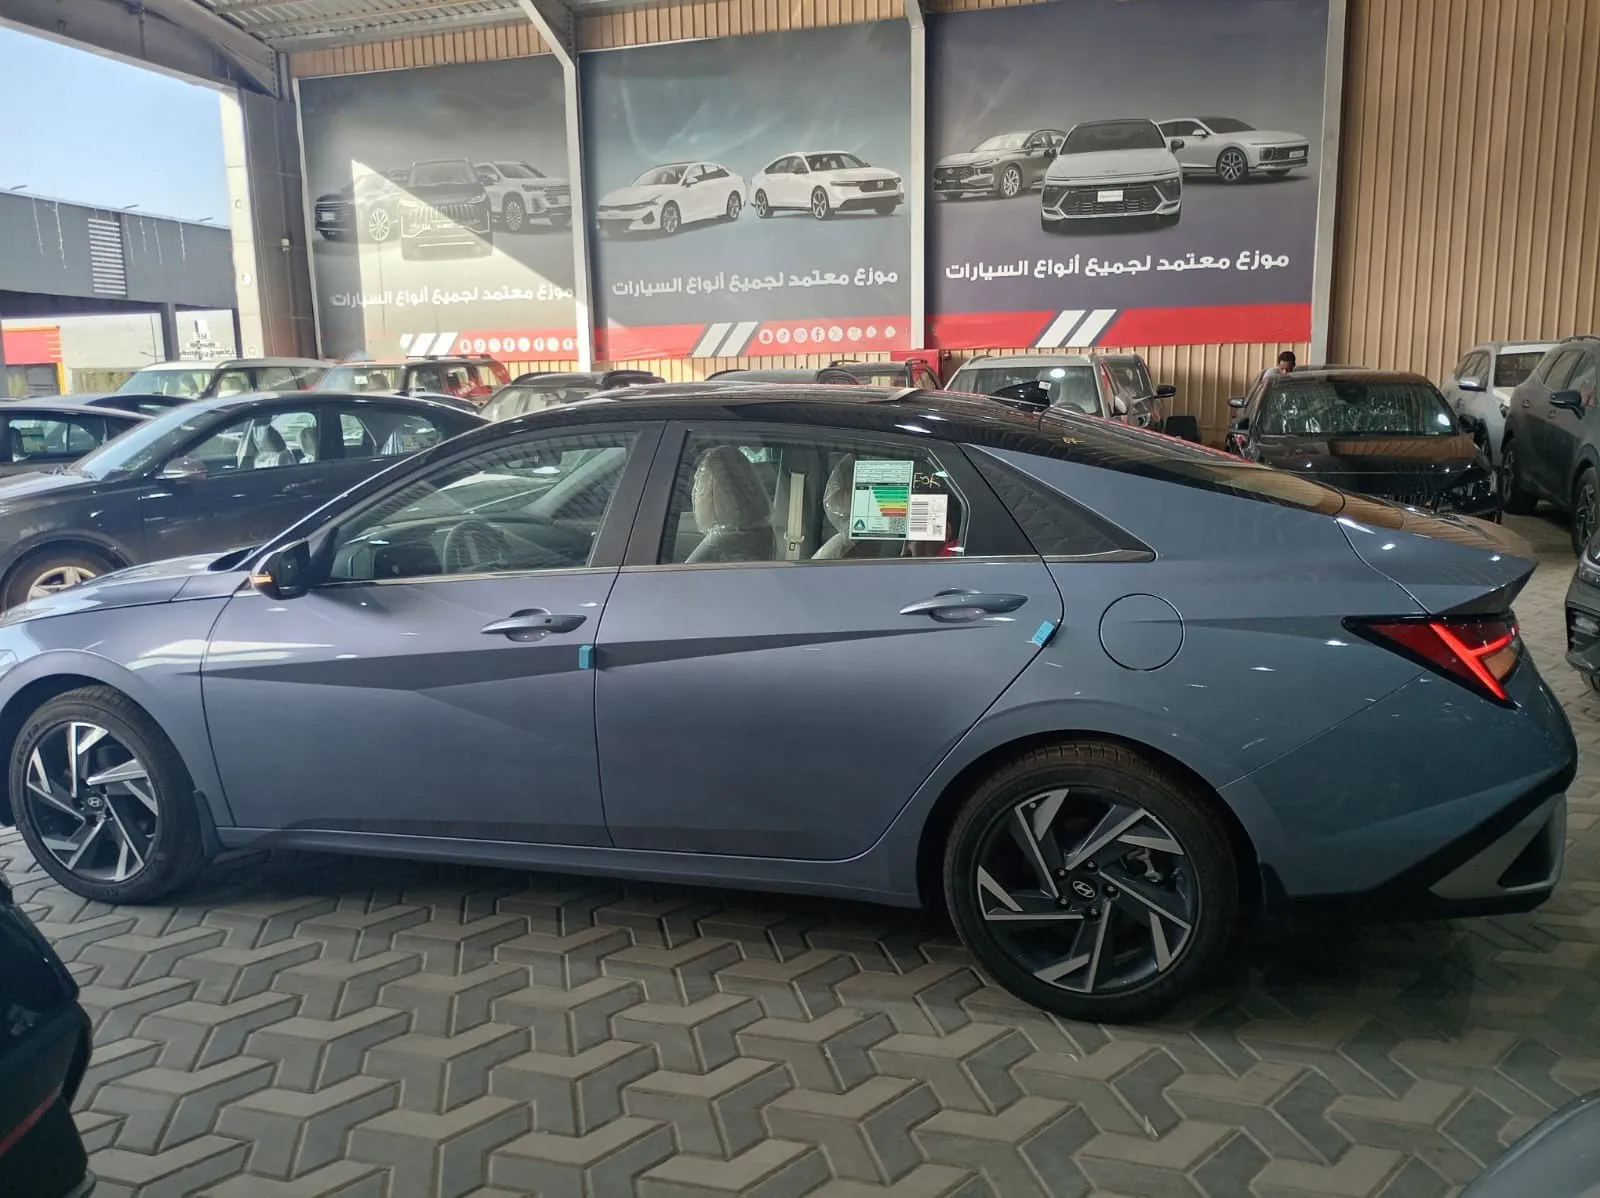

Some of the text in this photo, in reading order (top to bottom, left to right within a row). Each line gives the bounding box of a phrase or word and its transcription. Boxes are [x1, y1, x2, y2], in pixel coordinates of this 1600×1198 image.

[945, 249, 1290, 281] موزع معتمد لجميع أنواع السيارات
[329, 283, 573, 308] موزع معتمد لجميع أنواع السيارات
[612, 266, 898, 297] موزع معتمد لجميع أنواع السيارات
